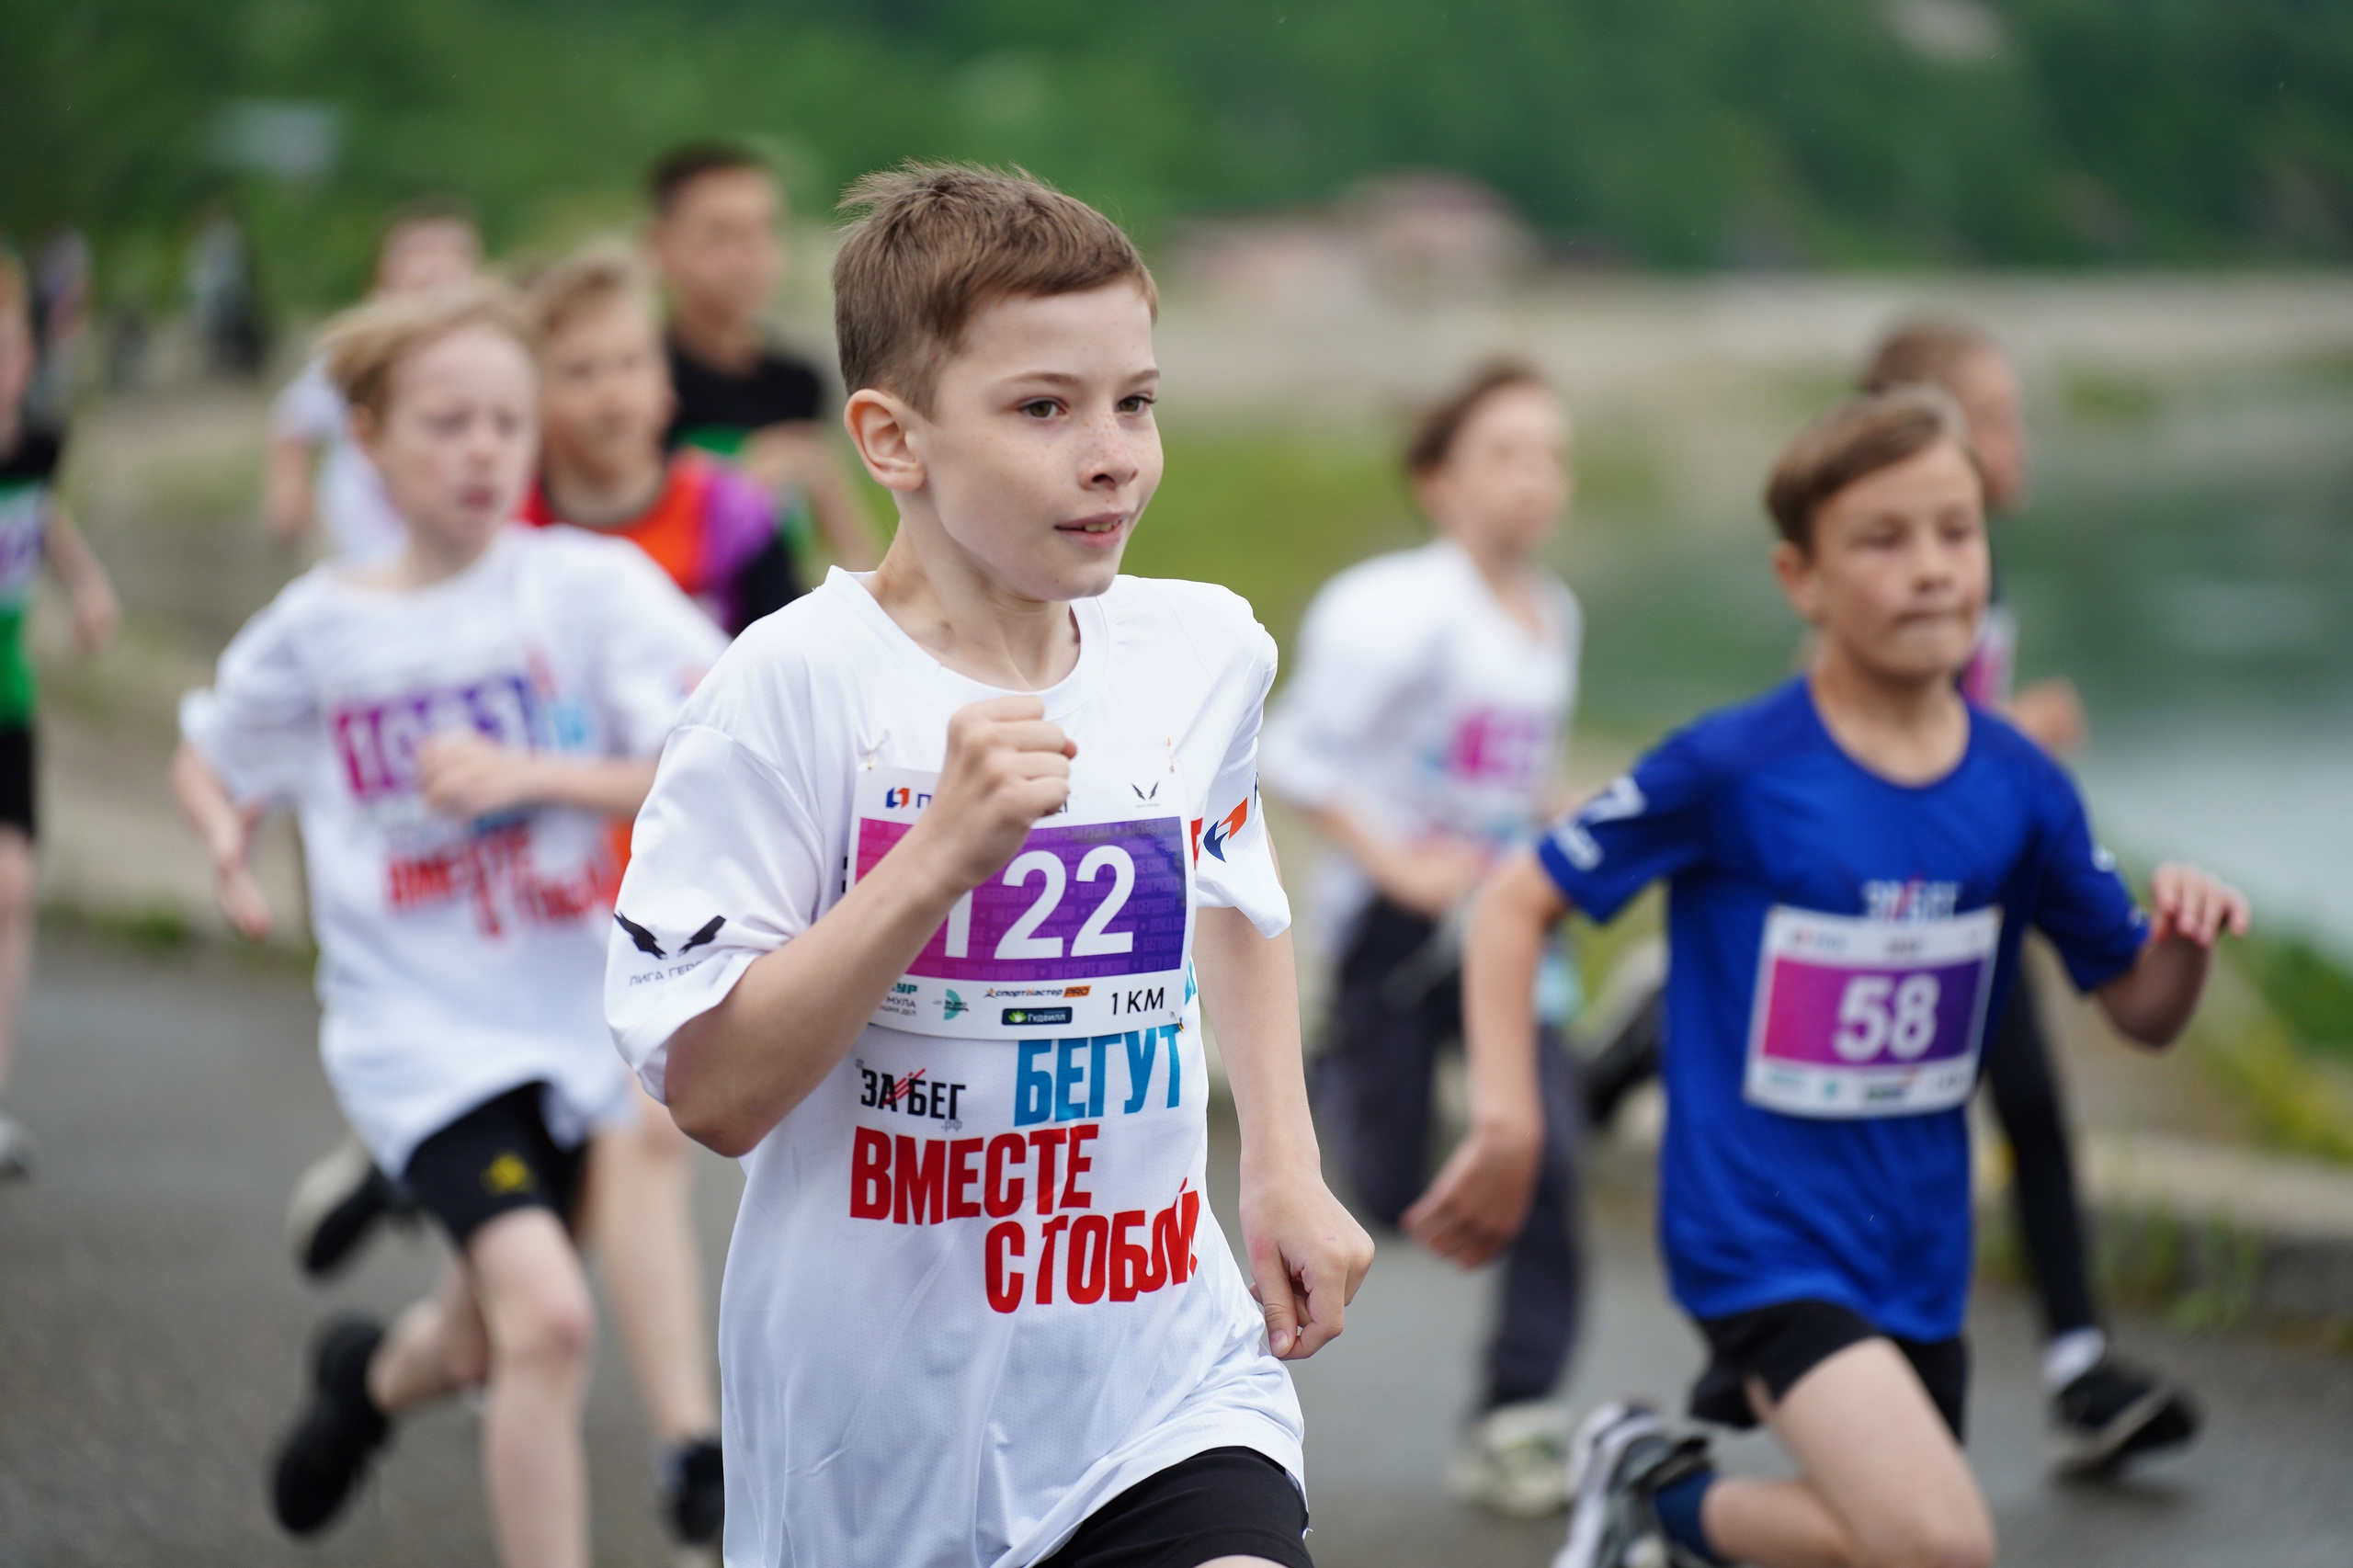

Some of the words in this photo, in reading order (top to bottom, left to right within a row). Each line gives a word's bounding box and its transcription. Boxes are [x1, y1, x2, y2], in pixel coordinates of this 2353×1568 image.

[946, 845, 1136, 960] 122
[630, 971, 665, 986] ЛИГА
[886, 996, 916, 1008] МУЛА
[1111, 993, 1119, 1016] 1
[1835, 974, 1940, 1061] 58
[1014, 1024, 1182, 1128] БЕГУТ
[850, 1125, 1099, 1225] ВМЕСТЕ
[986, 1221, 1026, 1313] С
